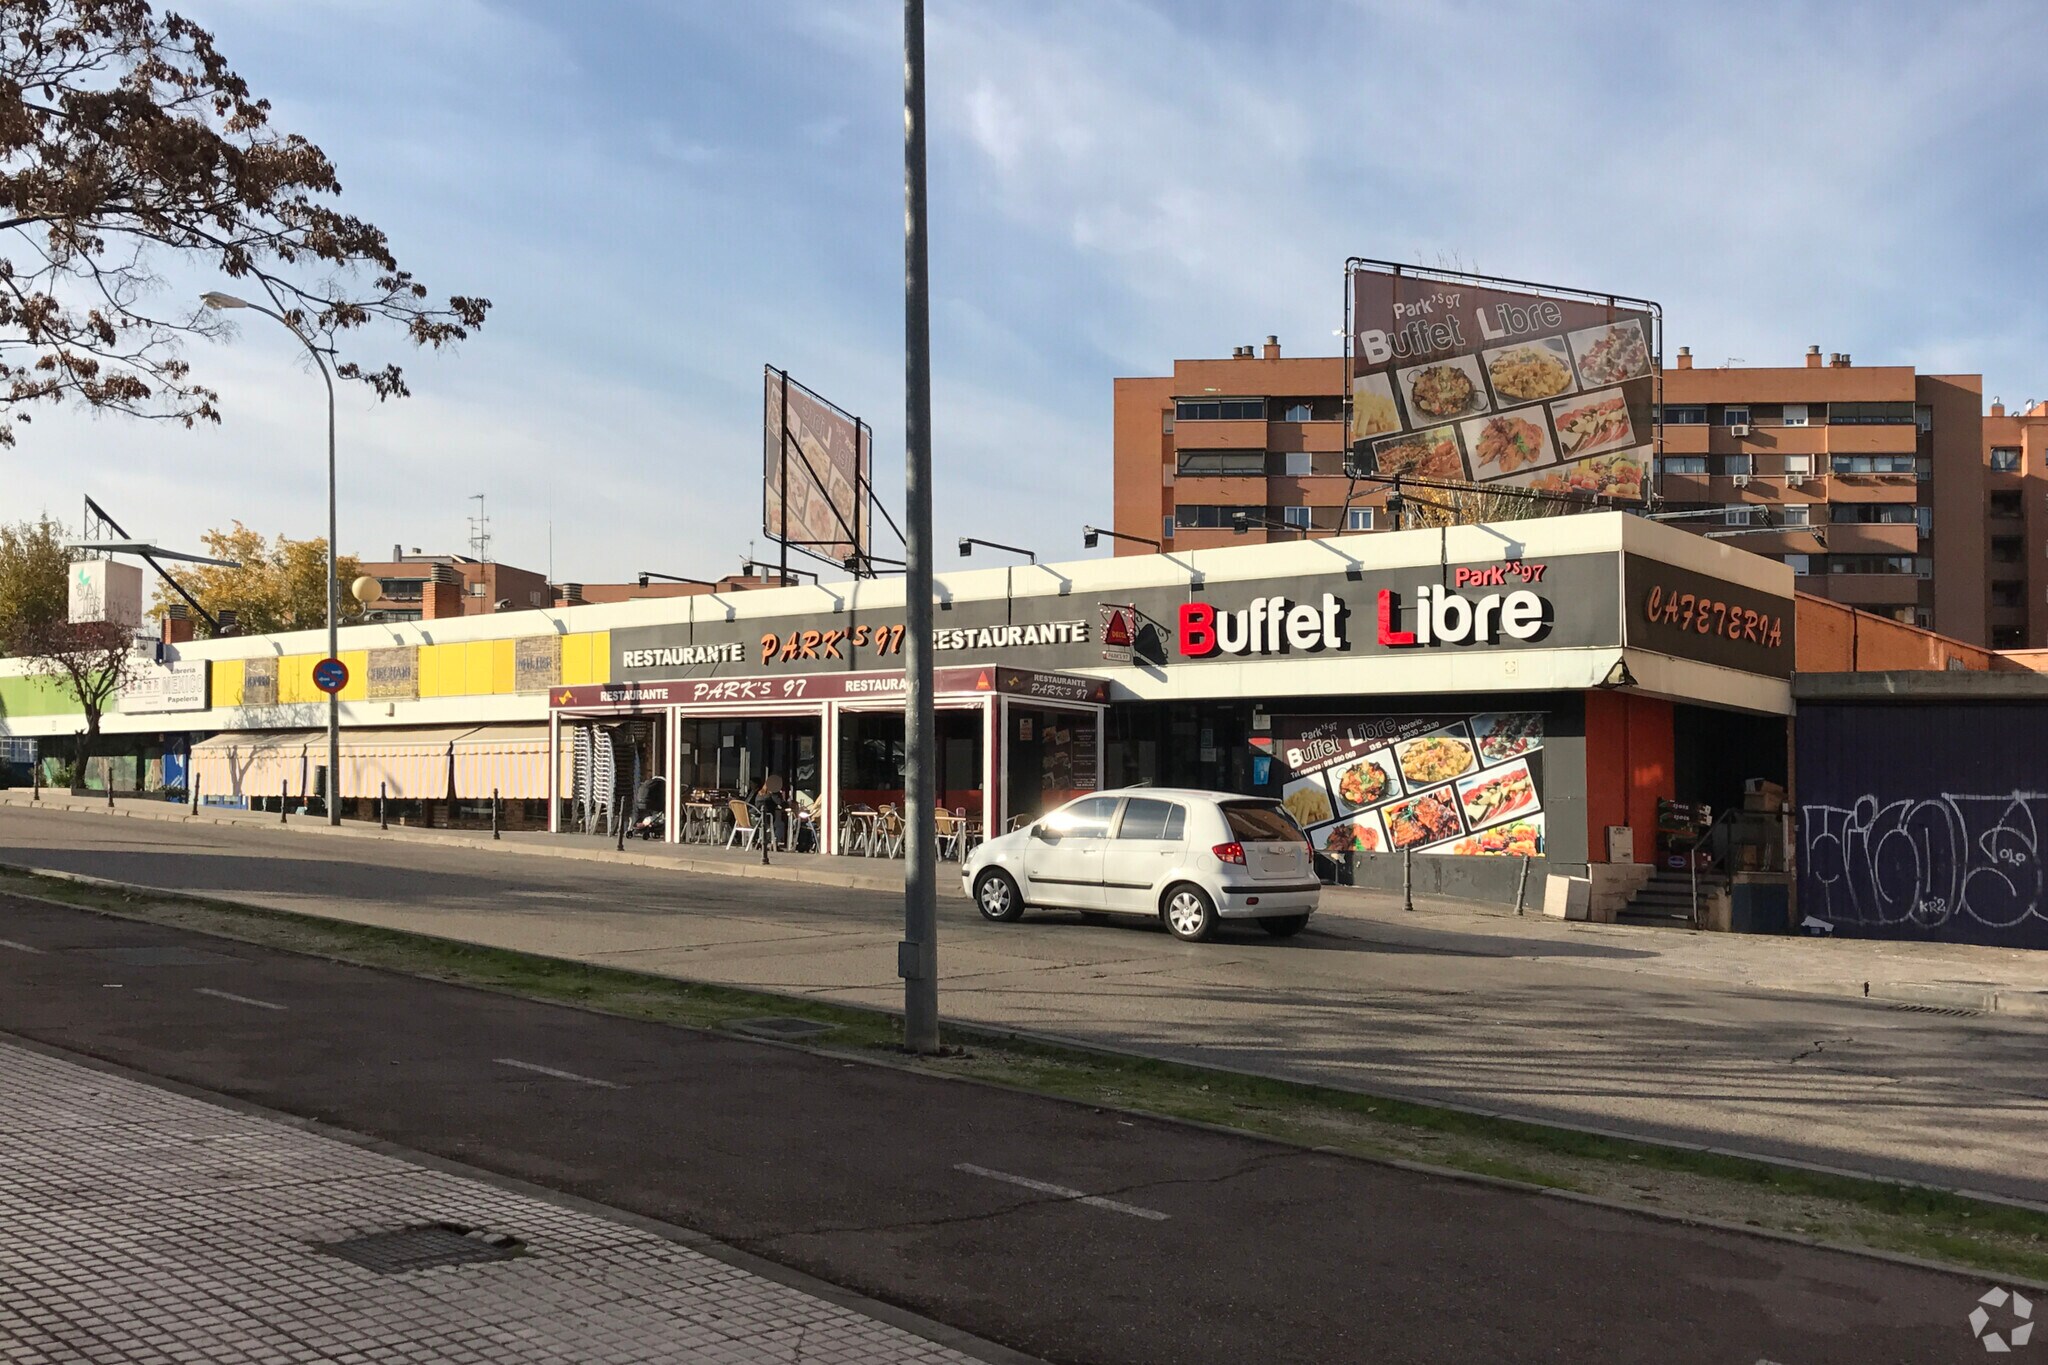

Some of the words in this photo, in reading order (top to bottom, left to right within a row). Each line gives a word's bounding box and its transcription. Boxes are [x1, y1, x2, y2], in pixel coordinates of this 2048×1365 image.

[1361, 314, 1466, 364] Buffet
[1476, 301, 1562, 341] Libre
[1178, 592, 1342, 656] Buffet
[1377, 583, 1543, 646] Libre
[1647, 585, 1782, 648] CAFETERIA
[622, 644, 744, 668] RESTAURANTE
[760, 624, 871, 666] PARK'S
[873, 624, 906, 656] 97
[600, 688, 669, 702] RESTAURANTE
[694, 680, 771, 702] PARK'S
[782, 679, 807, 699] 97
[1031, 682, 1072, 697] PARK'S
[1076, 688, 1088, 700] 97
[1033, 674, 1087, 687] RESTAURANTE
[1286, 734, 1342, 769] Buffet
[1346, 717, 1397, 747] Libre
